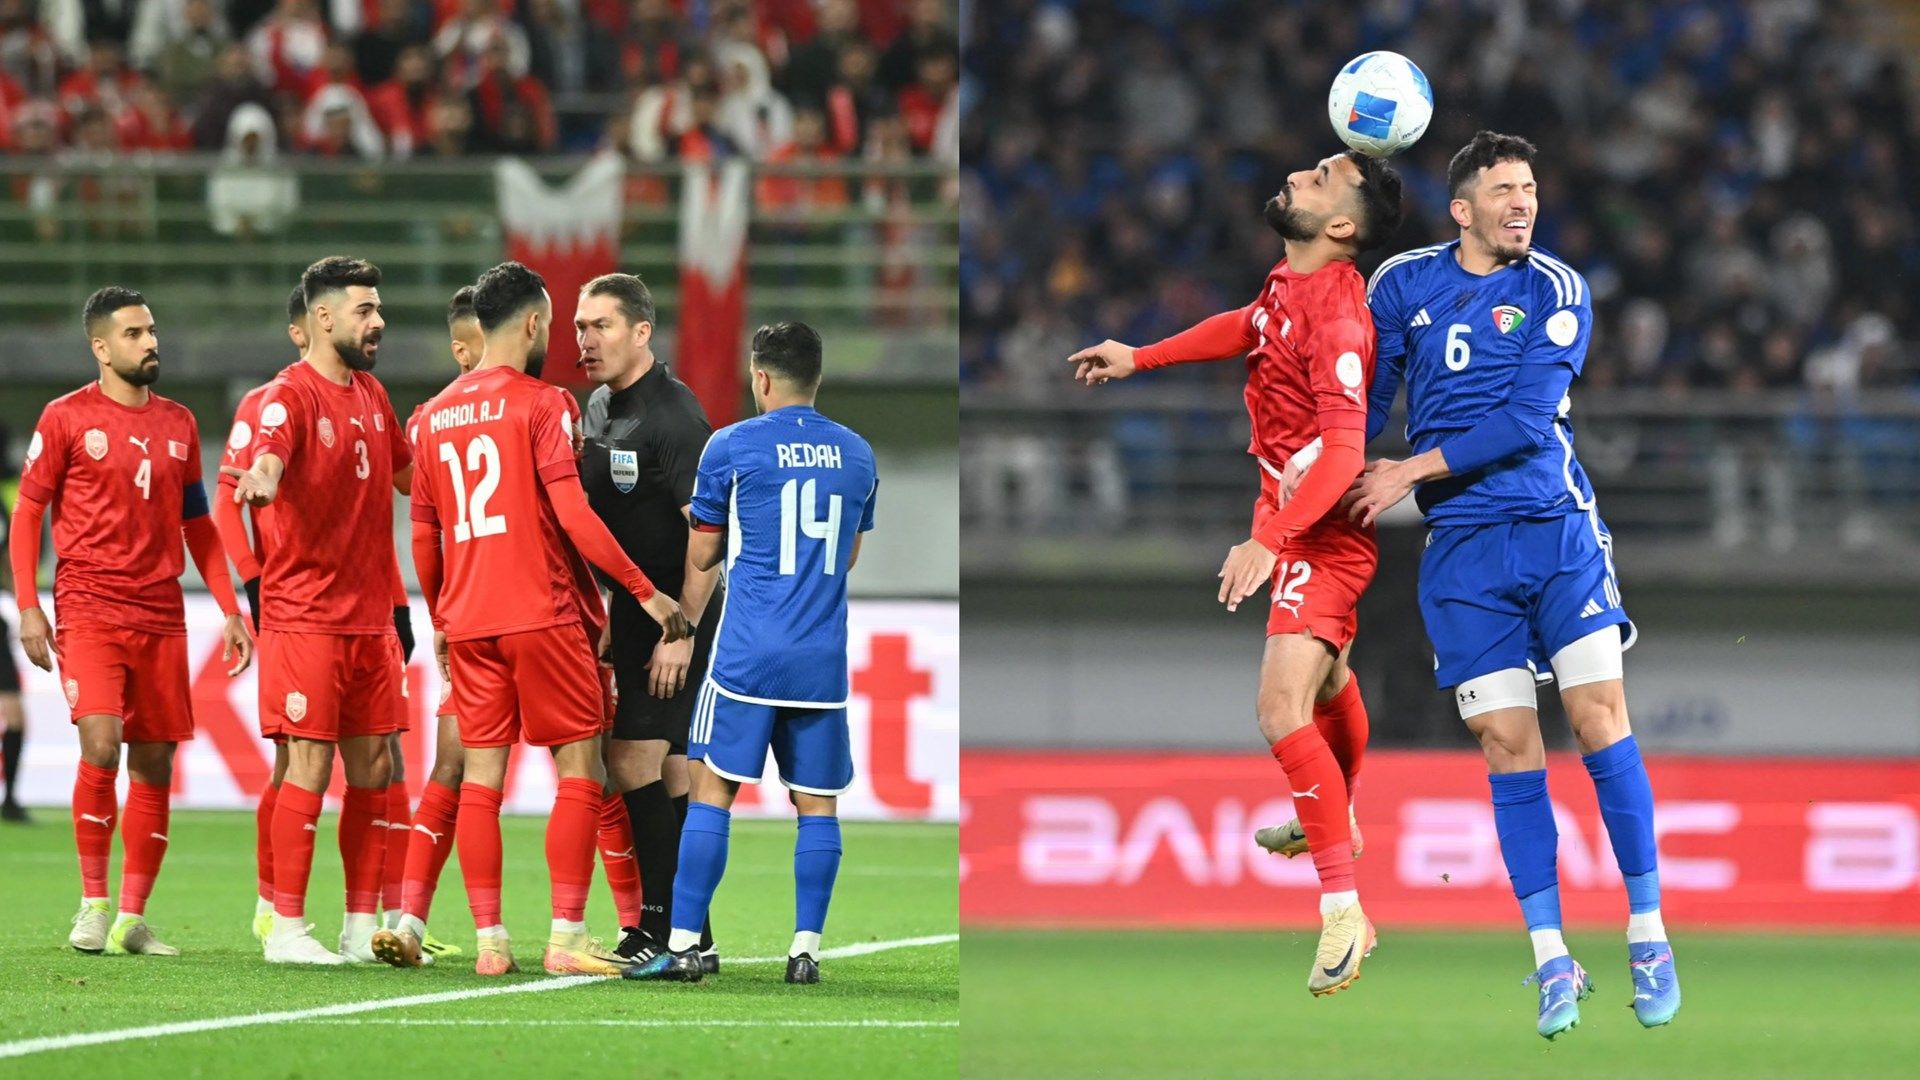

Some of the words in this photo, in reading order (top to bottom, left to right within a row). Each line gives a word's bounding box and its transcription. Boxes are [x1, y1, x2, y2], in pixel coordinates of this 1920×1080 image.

[1445, 323, 1472, 371] 6
[354, 439, 371, 480] 3
[613, 453, 635, 464] FIFA
[776, 443, 842, 469] REDAH
[133, 459, 152, 500] 4
[438, 433, 508, 544] 12
[779, 478, 842, 576] 14
[1271, 559, 1312, 605] 12
